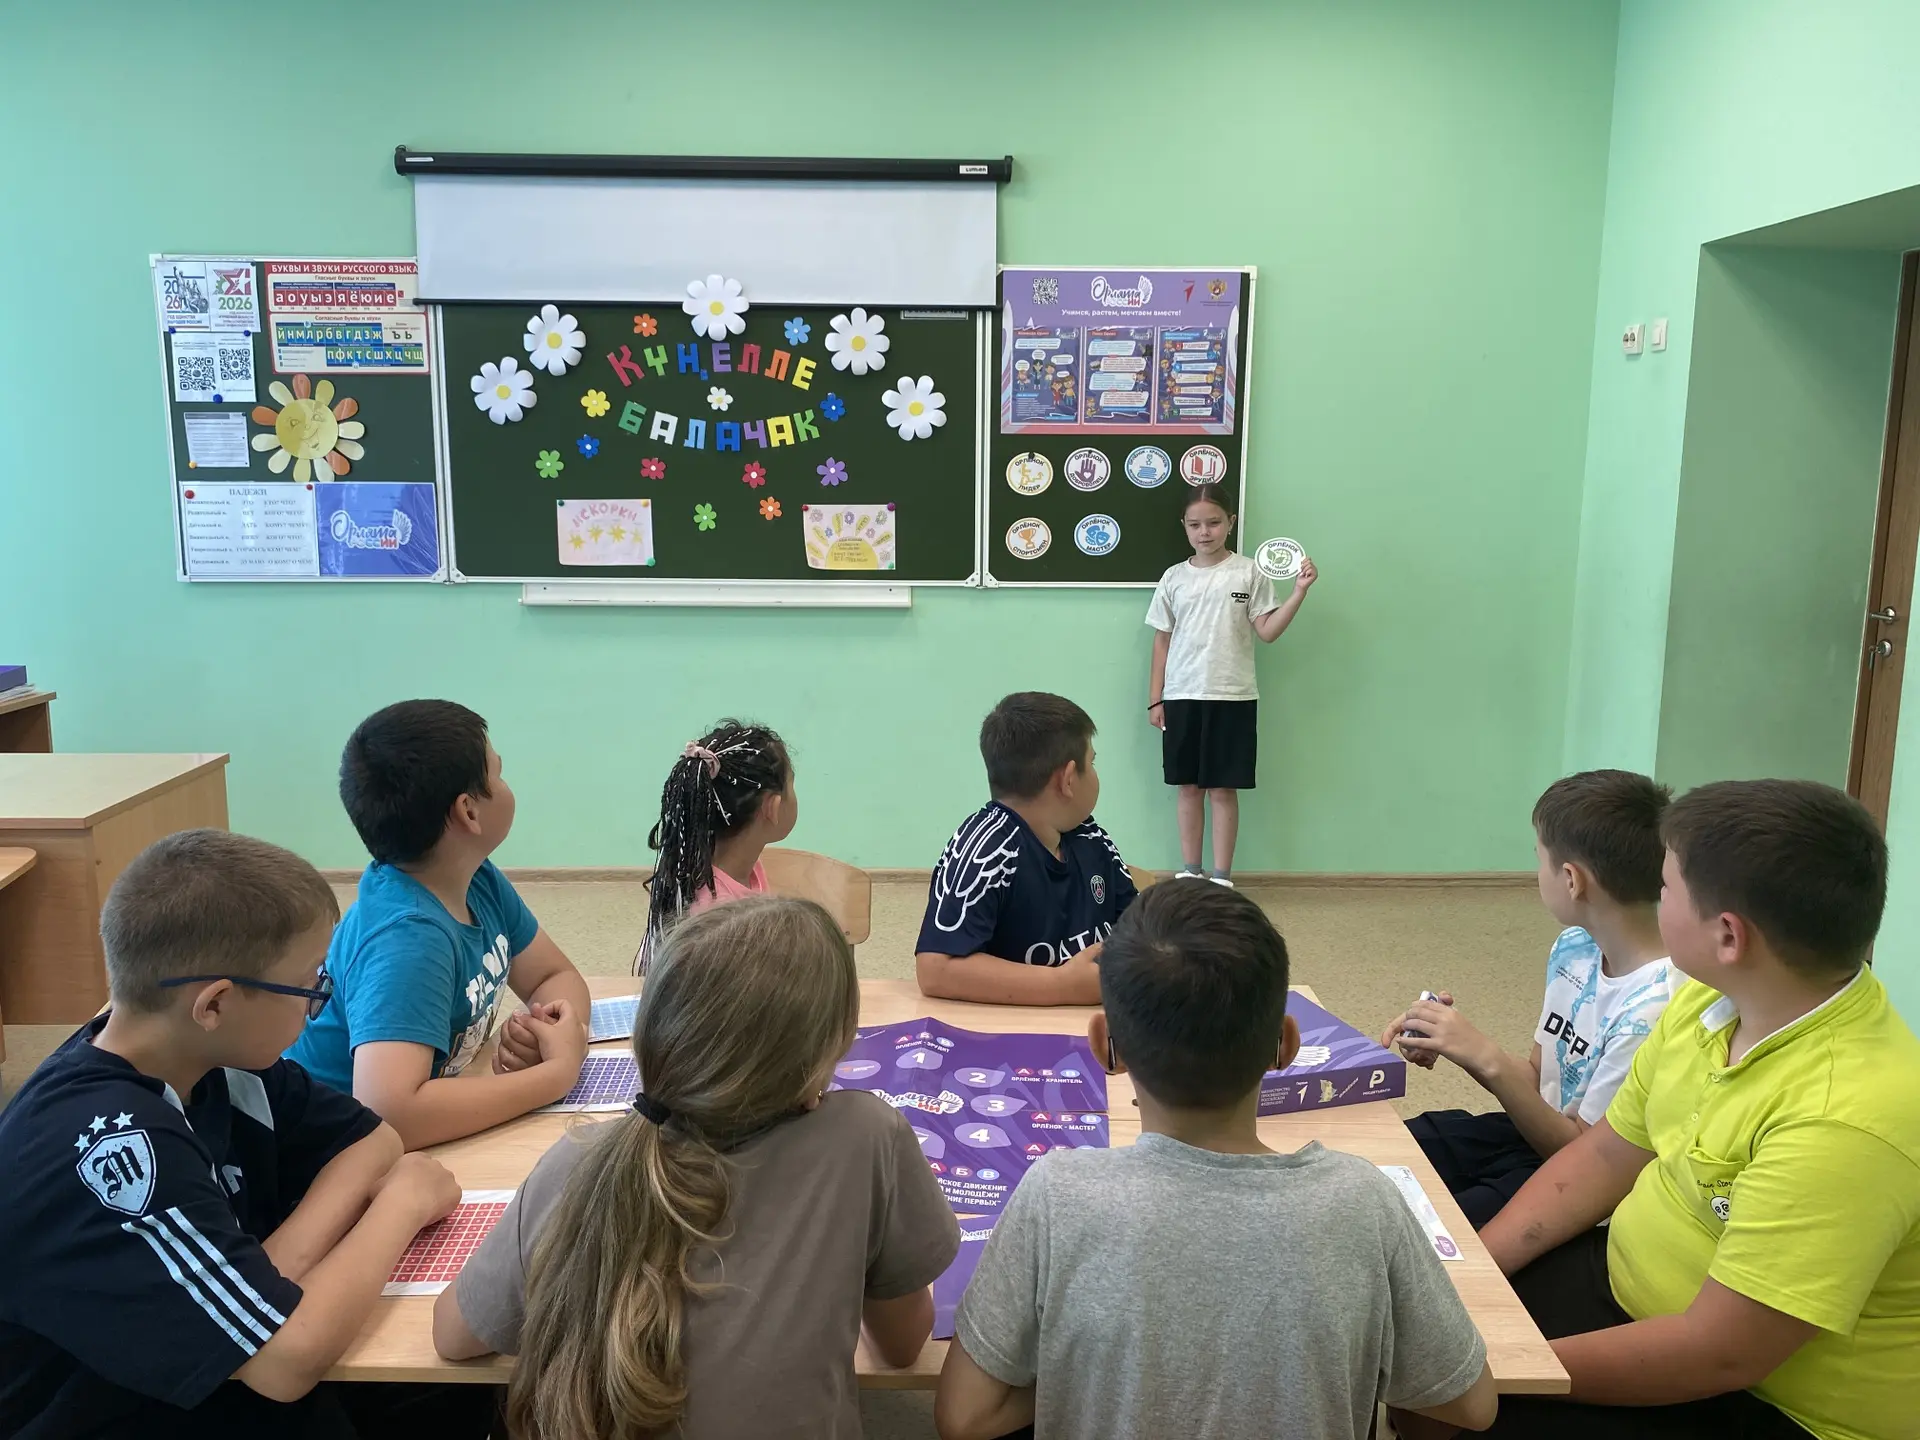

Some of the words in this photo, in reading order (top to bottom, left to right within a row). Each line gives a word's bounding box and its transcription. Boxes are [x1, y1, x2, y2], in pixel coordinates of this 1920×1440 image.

[272, 264, 301, 272] БУКВЫ
[342, 265, 387, 273] РУССКОГО
[388, 265, 418, 273] ЯЗЫКА
[1093, 278, 1141, 302] Орлята
[218, 297, 253, 310] 2026
[276, 293, 284, 302] а
[288, 293, 296, 303] о
[298, 293, 307, 305] у
[311, 293, 322, 303] ы
[325, 293, 332, 303] э
[338, 293, 346, 303] я
[350, 290, 358, 303] ё
[361, 293, 372, 303] ю
[374, 293, 382, 303] и
[387, 293, 395, 303] е
[1061, 309, 1091, 318] Учимся,
[1153, 309, 1182, 317] вместе!
[277, 328, 285, 339] й
[287, 330, 296, 339] н
[296, 330, 305, 339] м
[306, 330, 313, 339] л
[315, 330, 323, 341] р
[326, 327, 333, 339] б
[336, 330, 343, 339] в
[346, 330, 351, 339] г
[354, 330, 362, 340] д
[365, 330, 370, 339] з
[372, 330, 382, 339] ж
[327, 350, 334, 359] п
[336, 347, 344, 362] ф
[347, 350, 353, 359] к
[356, 350, 362, 360] т
[366, 350, 372, 360] с
[374, 350, 383, 360] ш
[384, 350, 392, 360] х
[394, 350, 403, 362] ц
[405, 351, 411, 360] ч
[413, 351, 424, 362] щ
[618, 400, 820, 452] БАЛАЧАК
[1074, 453, 1103, 463] ОРЛЁНОК
[1189, 449, 1219, 459] ОРЛЁНОК
[1070, 472, 1104, 487] ДОБРОВОЛЕЦ
[1189, 475, 1216, 484] ЭРУДИТ
[229, 488, 267, 496] ПАДЕЖИ
[1018, 484, 1041, 492] ЛИДЕР
[572, 502, 638, 528] ИСКОРКИ
[332, 511, 397, 545] Орлята
[1012, 522, 1041, 534] ОРЛЁНОК
[1081, 518, 1111, 530] ОРЛЁНОК
[1013, 540, 1048, 556] СПОРТСМЕН
[1086, 543, 1112, 552] МАСТЕР
[1267, 541, 1299, 554] ОРЛЁНОК
[1263, 564, 1290, 576] ЭКОЛОГ
[1025, 922, 1112, 966] QATA
[1544, 1012, 1590, 1062] DEP
[912, 1052, 926, 1064] 1
[969, 1072, 987, 1084] 2
[987, 1100, 1006, 1112] 3
[1034, 1113, 1048, 1121] А
[1061, 1114, 1073, 1122] Б
[1086, 1115, 1097, 1123] В
[969, 1129, 990, 1142] 4
[1028, 1144, 1042, 1152] А
[930, 1163, 942, 1172] А
[956, 1167, 969, 1176] Б
[983, 1170, 995, 1178] В
[937, 1177, 962, 1188] ЙСКОЕ
[963, 1182, 1008, 1192] ДВИЖЕНИЕ
[944, 1195, 963, 1204] НИЕ
